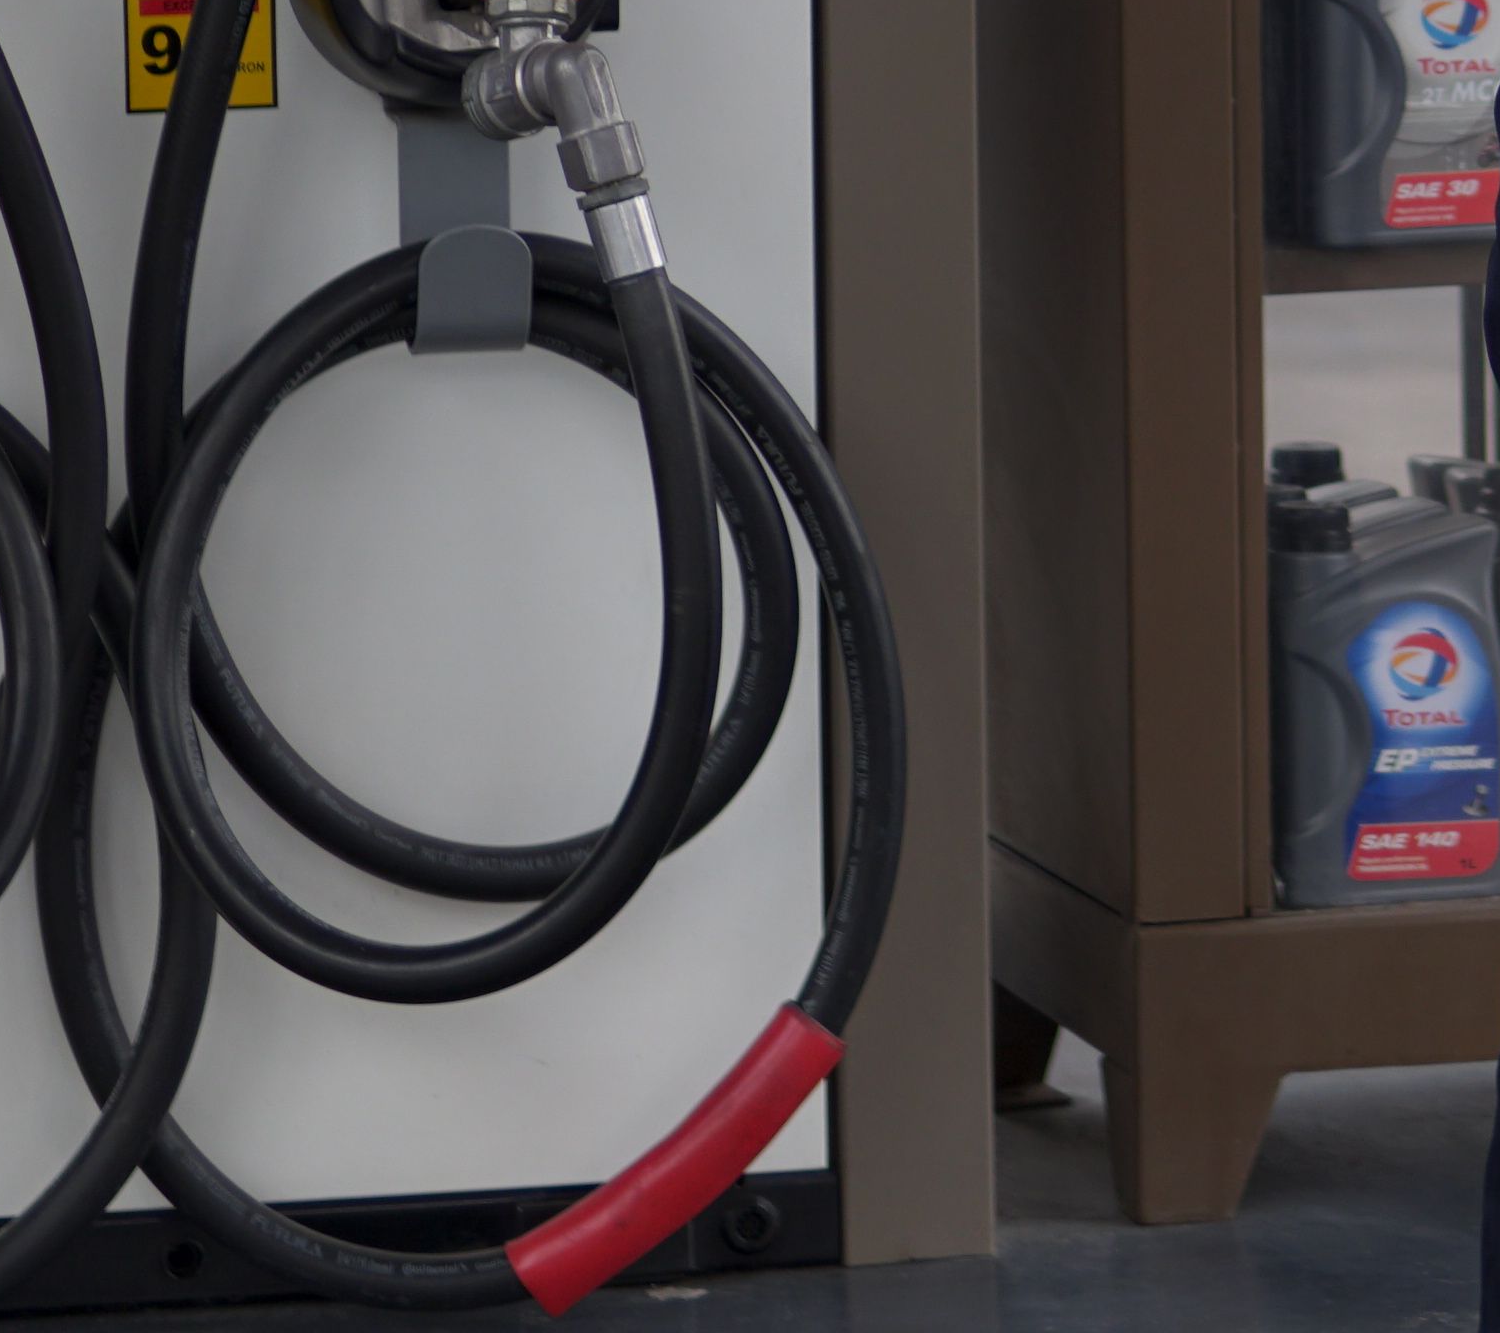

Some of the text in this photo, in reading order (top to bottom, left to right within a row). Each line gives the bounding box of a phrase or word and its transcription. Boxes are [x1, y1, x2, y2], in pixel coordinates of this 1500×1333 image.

[141, 24, 266, 76] 9 RON
[1417, 57, 1497, 75] TOTAL
[1451, 79, 1499, 102] MC
[1395, 183, 1443, 200] SAE
[1382, 708, 1468, 727] TOTAL
[1374, 748, 1419, 774] EP
[1359, 830, 1460, 850] SAE 140
